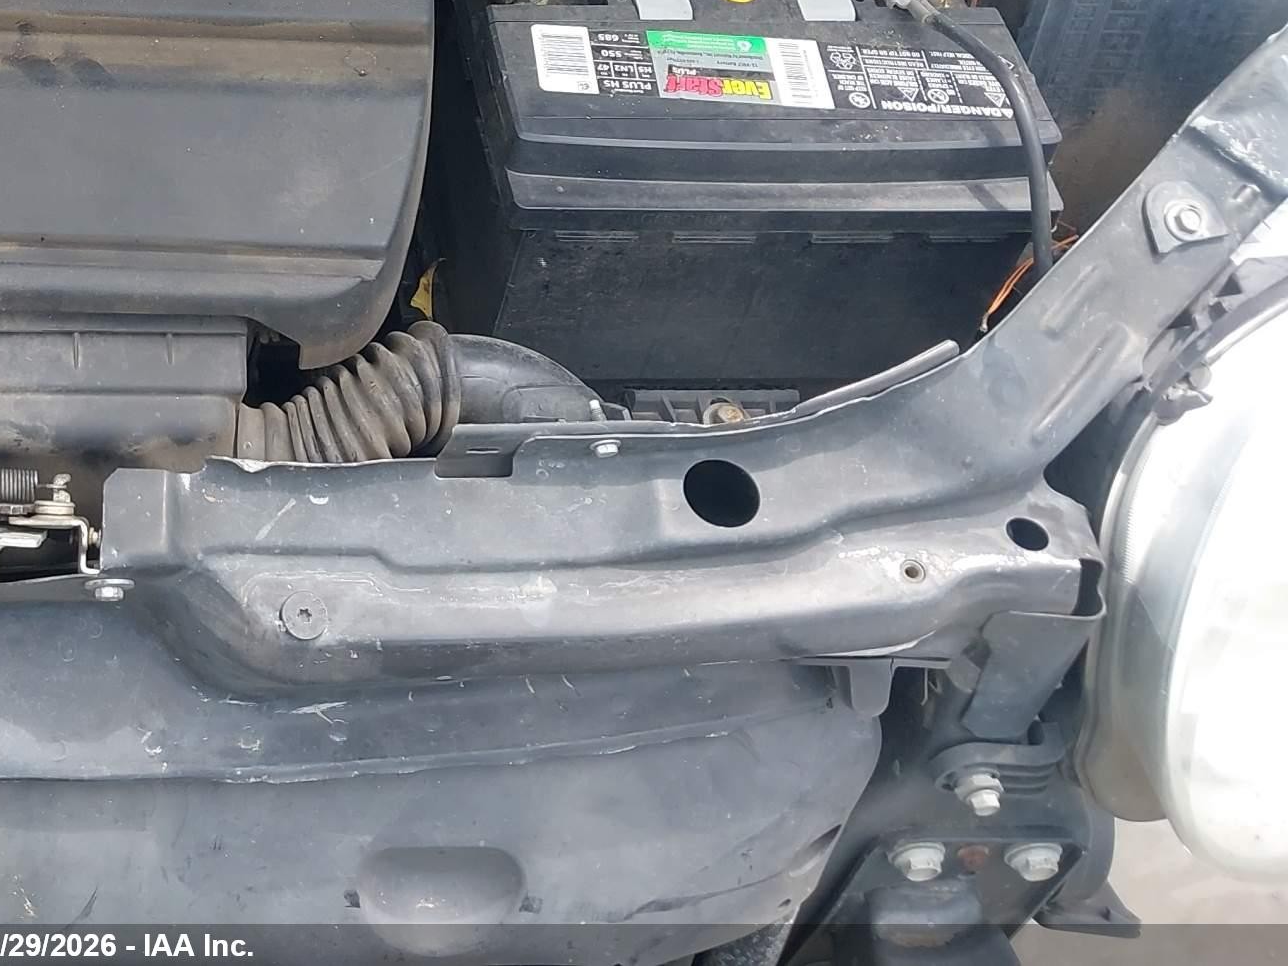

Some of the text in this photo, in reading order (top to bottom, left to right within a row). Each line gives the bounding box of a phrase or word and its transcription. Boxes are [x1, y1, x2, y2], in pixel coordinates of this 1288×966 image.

[601, 50, 622, 58] 550
[672, 66, 697, 75] PLUS
[622, 81, 652, 90] PLUS
[664, 75, 772, 100] EverStart
[880, 100, 1002, 117] DANGER/POISON
